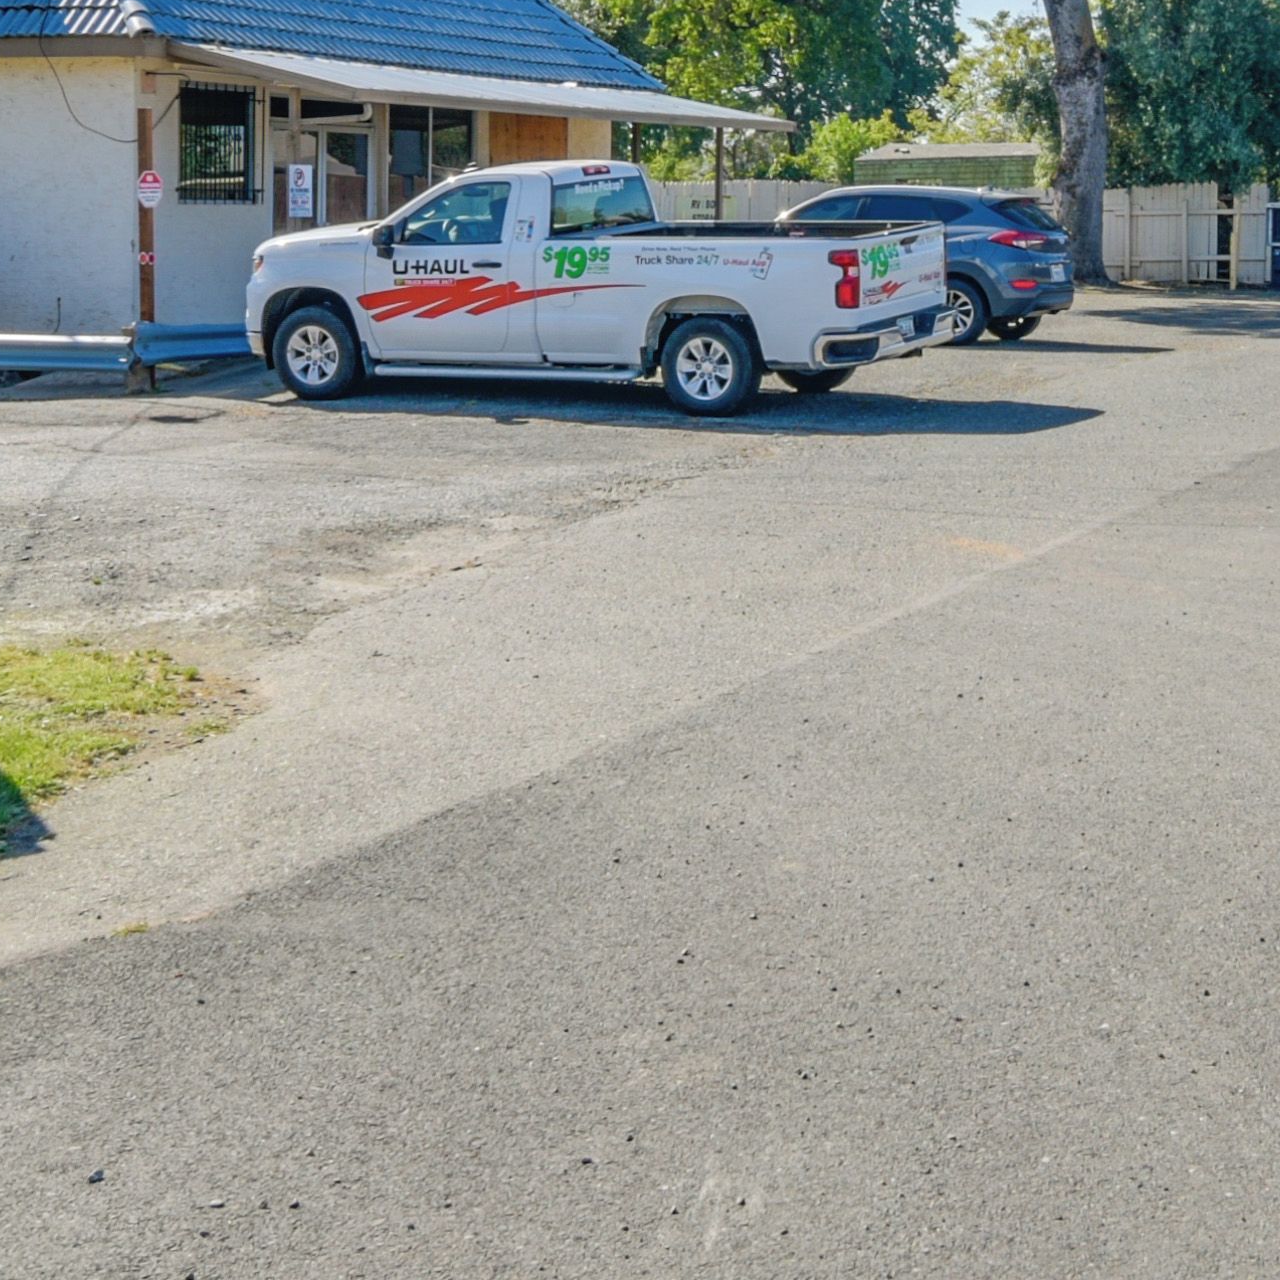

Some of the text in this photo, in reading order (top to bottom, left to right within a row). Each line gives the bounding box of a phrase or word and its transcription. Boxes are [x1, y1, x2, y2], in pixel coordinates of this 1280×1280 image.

[392, 259, 470, 275] U-HAUL
[635, 254, 720, 266] Truck Share 24/7
